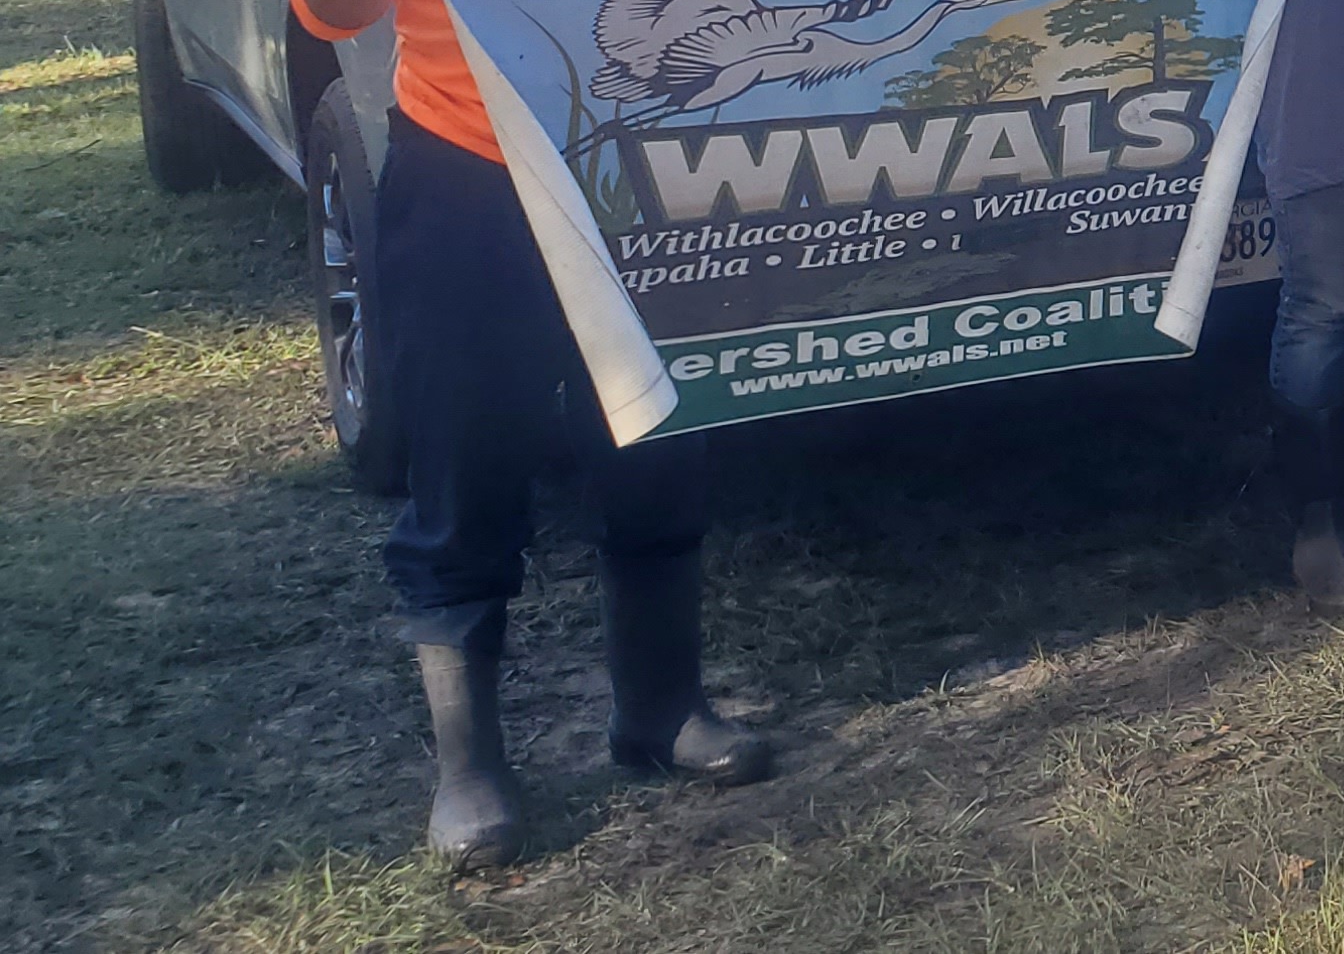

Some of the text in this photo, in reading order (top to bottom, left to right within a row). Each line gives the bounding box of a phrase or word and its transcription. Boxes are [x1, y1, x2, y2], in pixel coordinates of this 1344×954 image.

[640, 89, 1198, 222] WWALS
[618, 173, 1203, 260] Withlacoochee Willacoochee
[796, 235, 907, 270] Little
[1065, 202, 1195, 235] Suwan
[664, 315, 930, 382] ershed
[731, 330, 1068, 397] www.wwals.net
